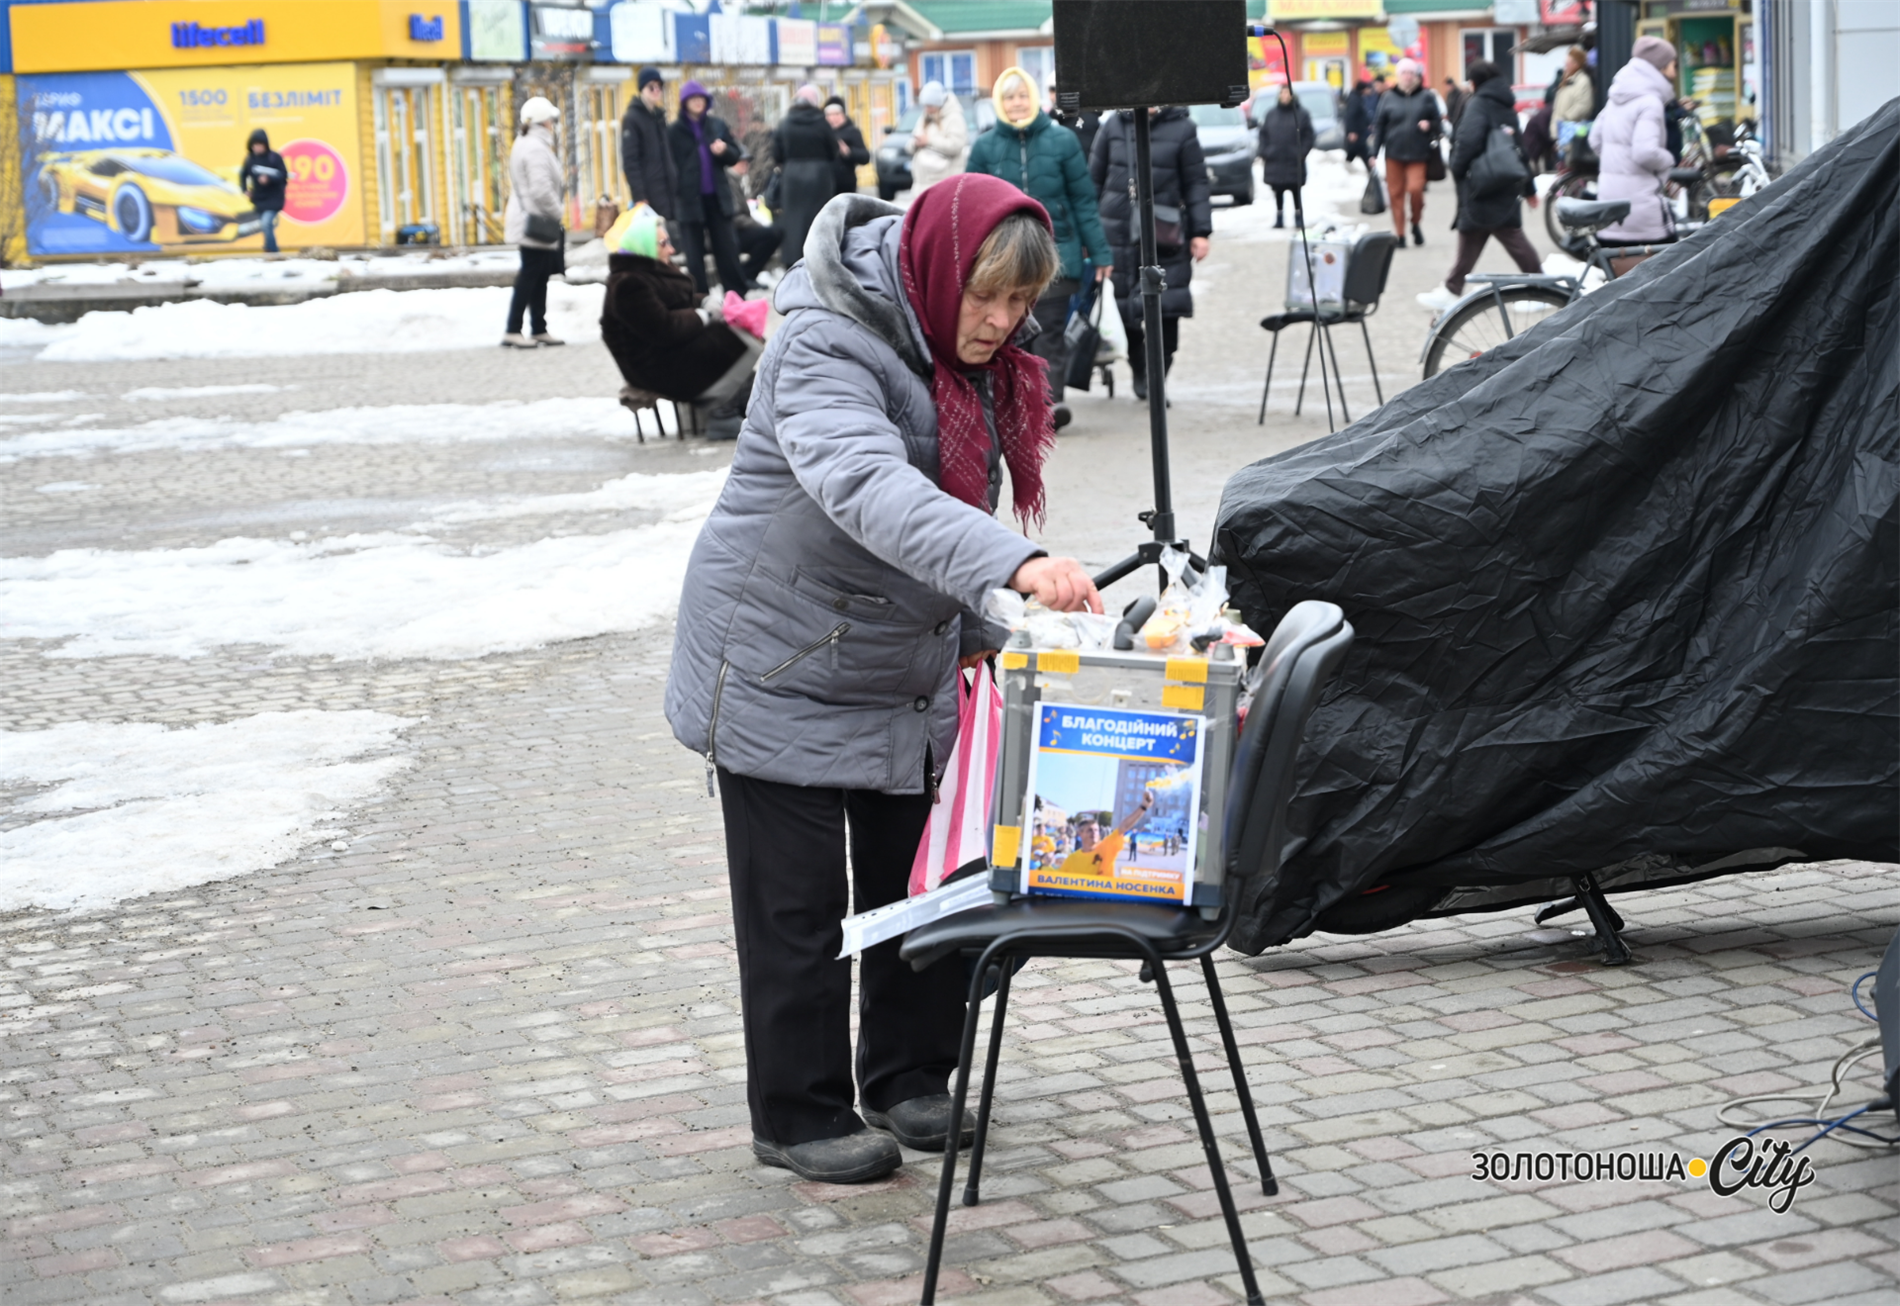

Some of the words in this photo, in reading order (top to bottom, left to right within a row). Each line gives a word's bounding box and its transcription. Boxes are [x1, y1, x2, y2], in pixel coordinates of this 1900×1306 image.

[171, 19, 264, 48] lifecell
[179, 89, 227, 106] 1500
[248, 90, 342, 109] БЕЗЛІМІТ
[33, 107, 153, 142] МАКСІ
[1062, 715, 1177, 738] БЛАГОДІЙНИЙ
[1081, 733, 1156, 751] КОНЦЕРТ
[1037, 875, 1112, 890] ВАЛЕНТИНА
[1116, 881, 1175, 895] НОСЕНКА
